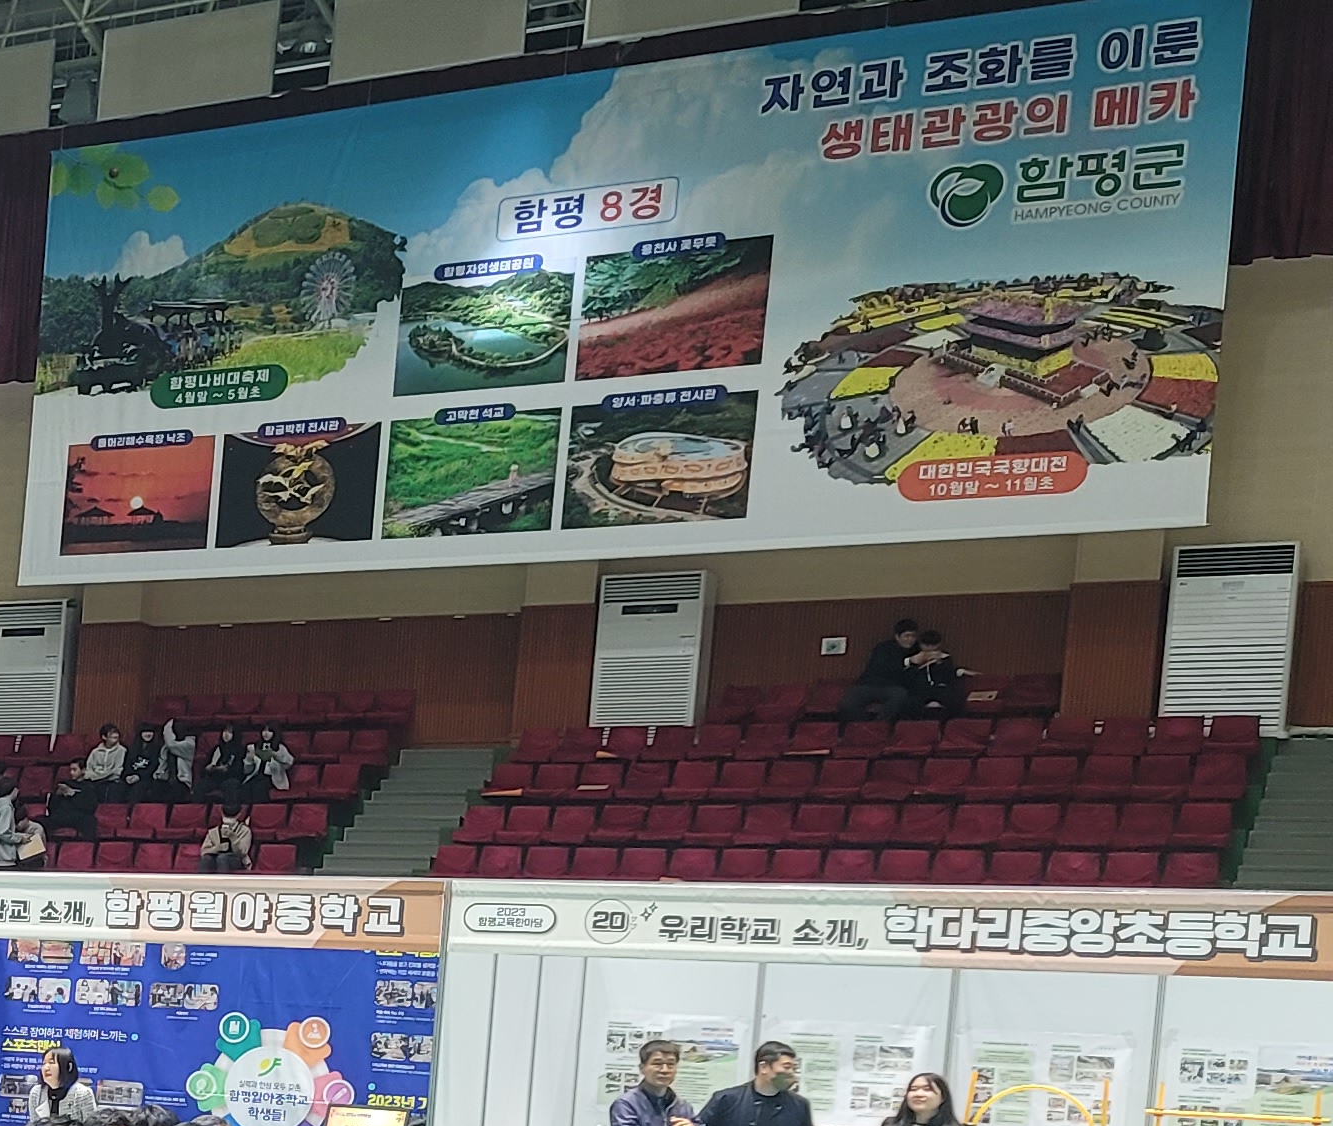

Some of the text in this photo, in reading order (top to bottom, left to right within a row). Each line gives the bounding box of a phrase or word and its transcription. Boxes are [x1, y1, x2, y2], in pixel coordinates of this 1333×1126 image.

[761, 20, 1200, 114] 자연과 조화를 이룬
[821, 79, 1196, 160] 생태관광의 메카
[1016, 144, 1185, 203] 함평군
[514, 184, 663, 234] 함평 8경
[1014, 193, 1180, 222] HAMPYEONG COUNTY
[169, 368, 270, 390] 함평나비대축제
[174, 389, 208, 405] 4월말
[227, 386, 261, 402] 5월초
[679, 388, 717, 402] 전시관
[307, 420, 340, 434] 전시관
[918, 455, 1068, 480] 대한민국국향대전
[929, 479, 980, 497] 10월말
[1005, 476, 1055, 492] 11월초
[39, 900, 94, 927] 소개,
[105, 888, 405, 936] 함평월야중학교
[478, 916, 544, 928] 함평교육한마당
[496, 907, 526, 917] 2023
[591, 910, 628, 932] 20
[658, 904, 1318, 961] 우리학교 소개, 학다리중앙초등학교
[367, 1093, 415, 1109] 2023년
